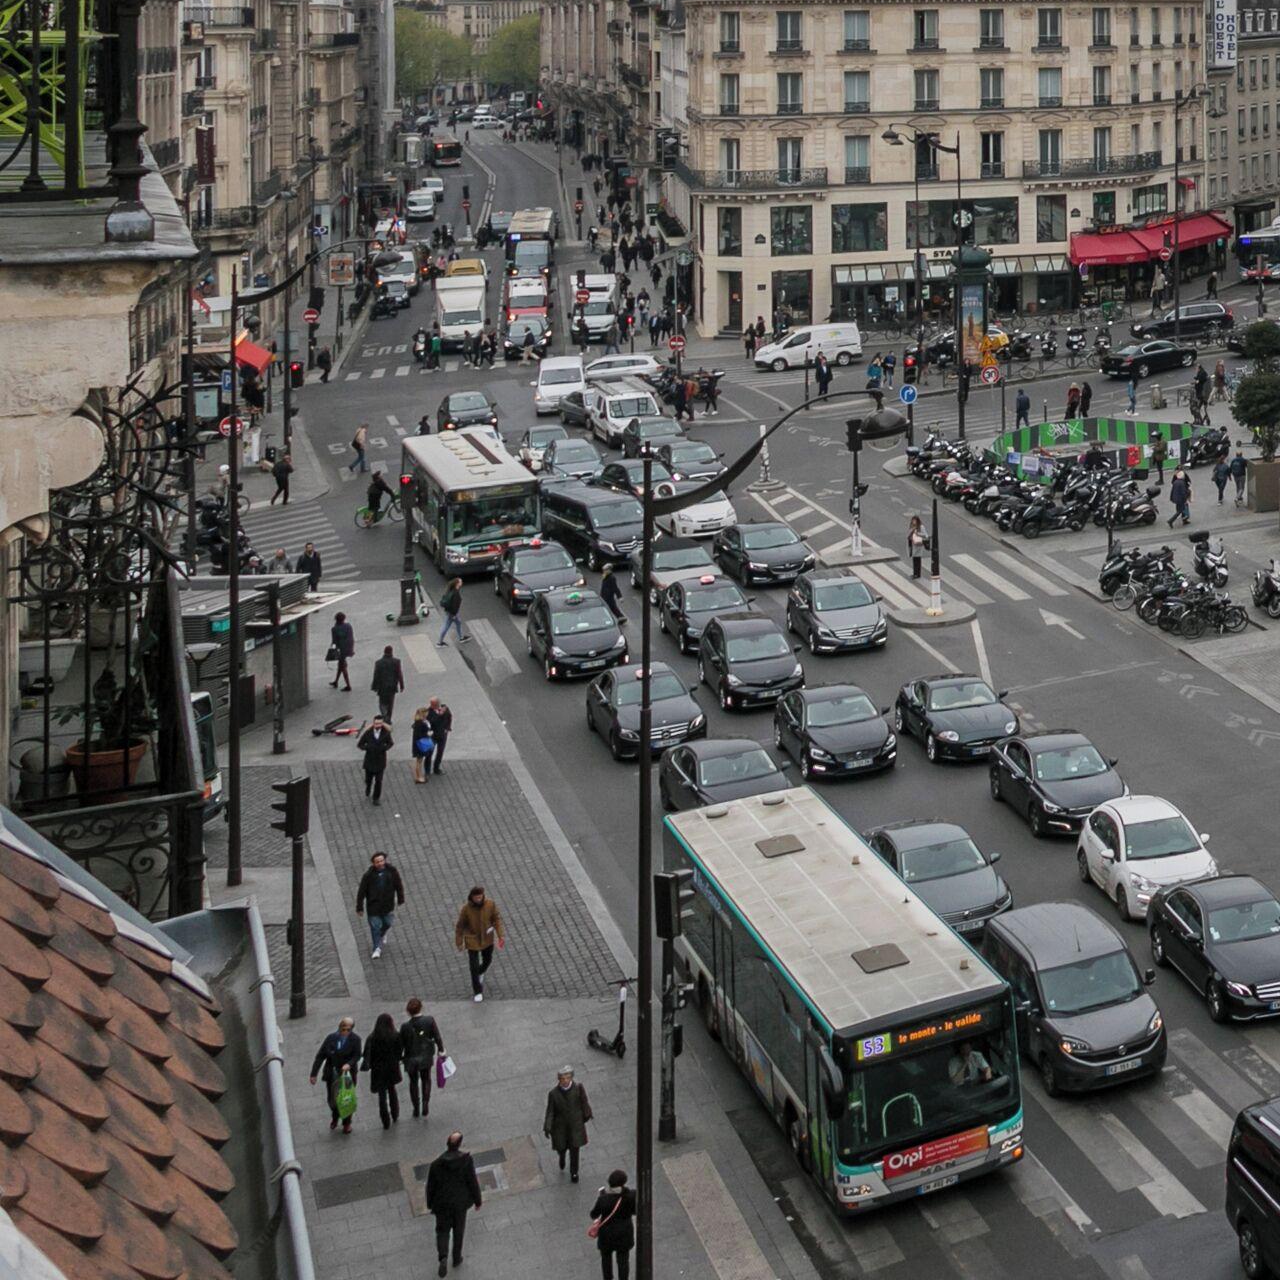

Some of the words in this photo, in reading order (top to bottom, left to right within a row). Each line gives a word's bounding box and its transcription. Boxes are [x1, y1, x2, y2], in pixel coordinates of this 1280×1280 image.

[1226, 14, 1236, 60] HOTEL
[863, 1035, 885, 1057] 53
[909, 1026, 937, 1040] monte
[955, 1013, 982, 1028] valide
[888, 1146, 923, 1170] Orpi
